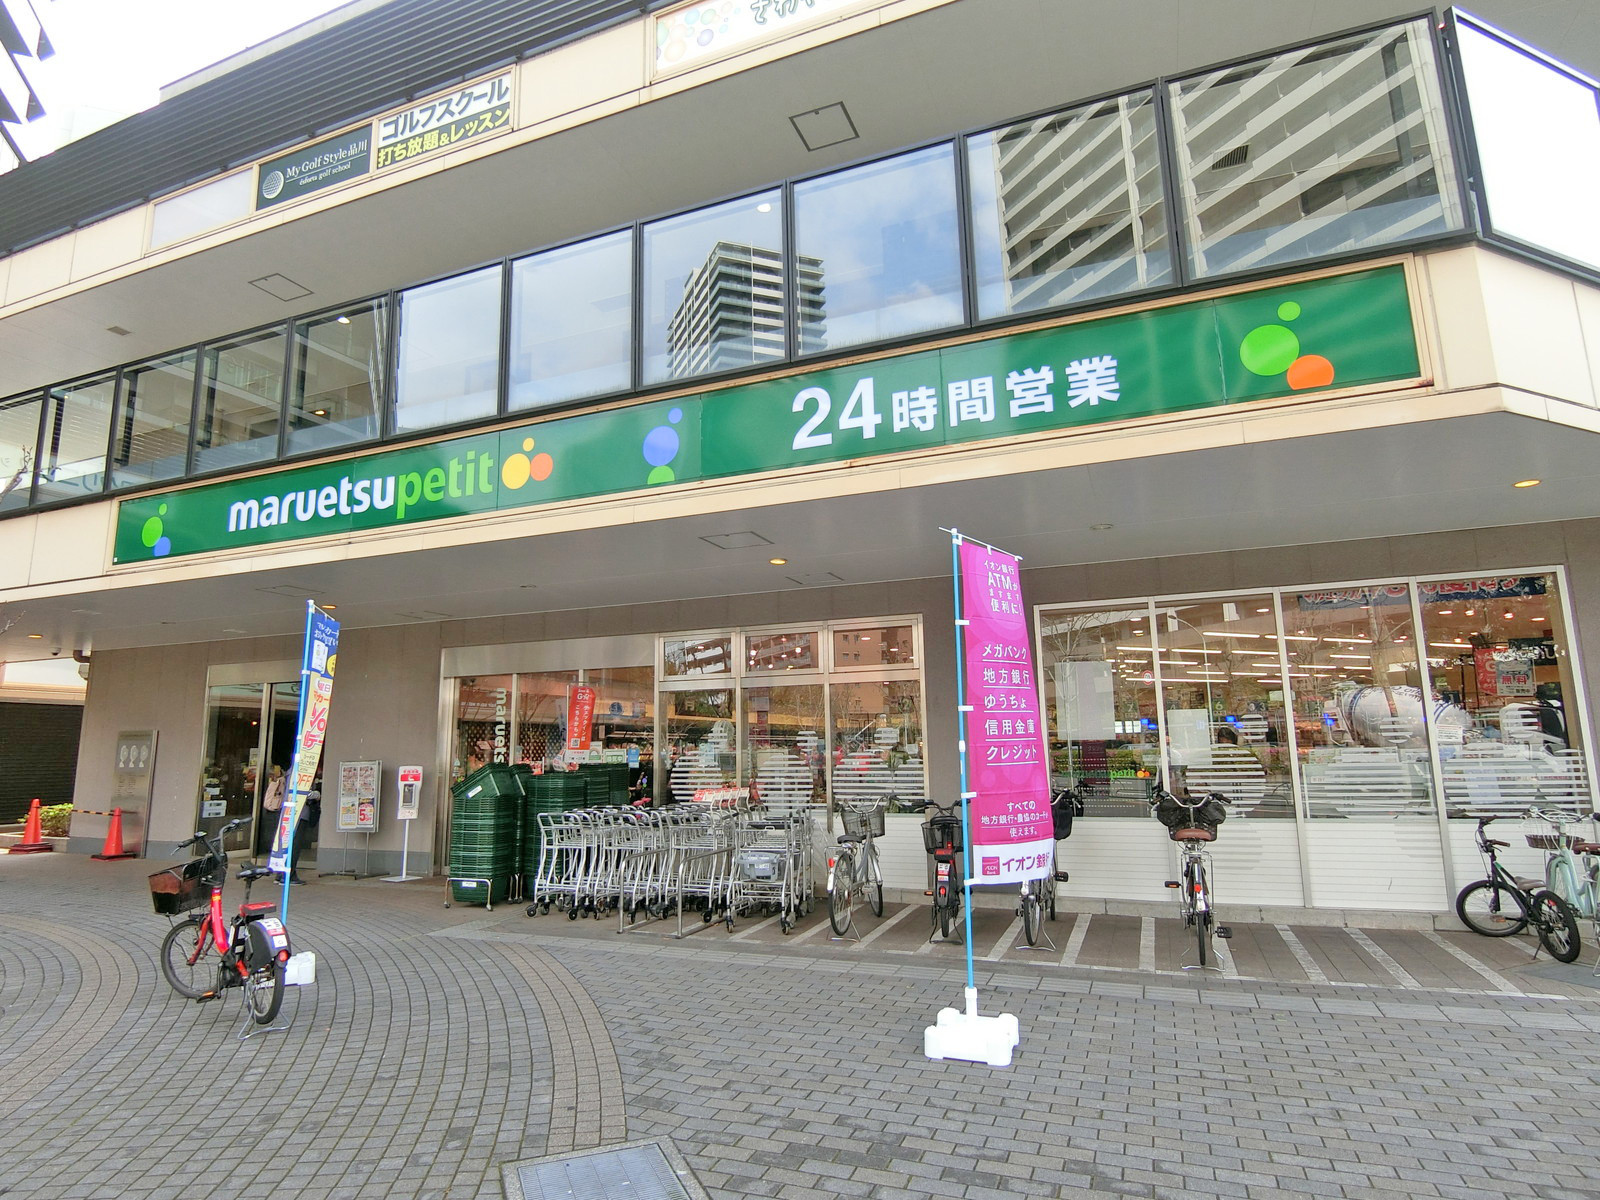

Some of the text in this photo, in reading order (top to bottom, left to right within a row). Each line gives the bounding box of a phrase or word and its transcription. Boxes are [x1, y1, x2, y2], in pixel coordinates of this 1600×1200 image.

[382, 78, 510, 141] ゴルフスクール
[378, 108, 511, 168] 打ち放題&レッスン
[286, 162, 301, 179] My
[301, 156, 323, 172] Golf
[323, 150, 347, 168] Style
[318, 168, 331, 181] golf
[332, 162, 351, 176] school
[792, 355, 1120, 451] 24時間営業
[984, 560, 1014, 576] イオン銀行
[991, 599, 1023, 616] 便利に!
[982, 643, 1027, 660] メガバンク
[983, 667, 1030, 686] 地方銀行
[1501, 674, 1528, 685] 無料
[984, 693, 1027, 709] ゆうちょ
[1216, 702, 1223, 710] 6
[985, 719, 1036, 736] 信用金庫
[986, 745, 1037, 761] クレジット
[1006, 800, 1036, 812] すべての
[1010, 826, 1037, 838] 使えます。
